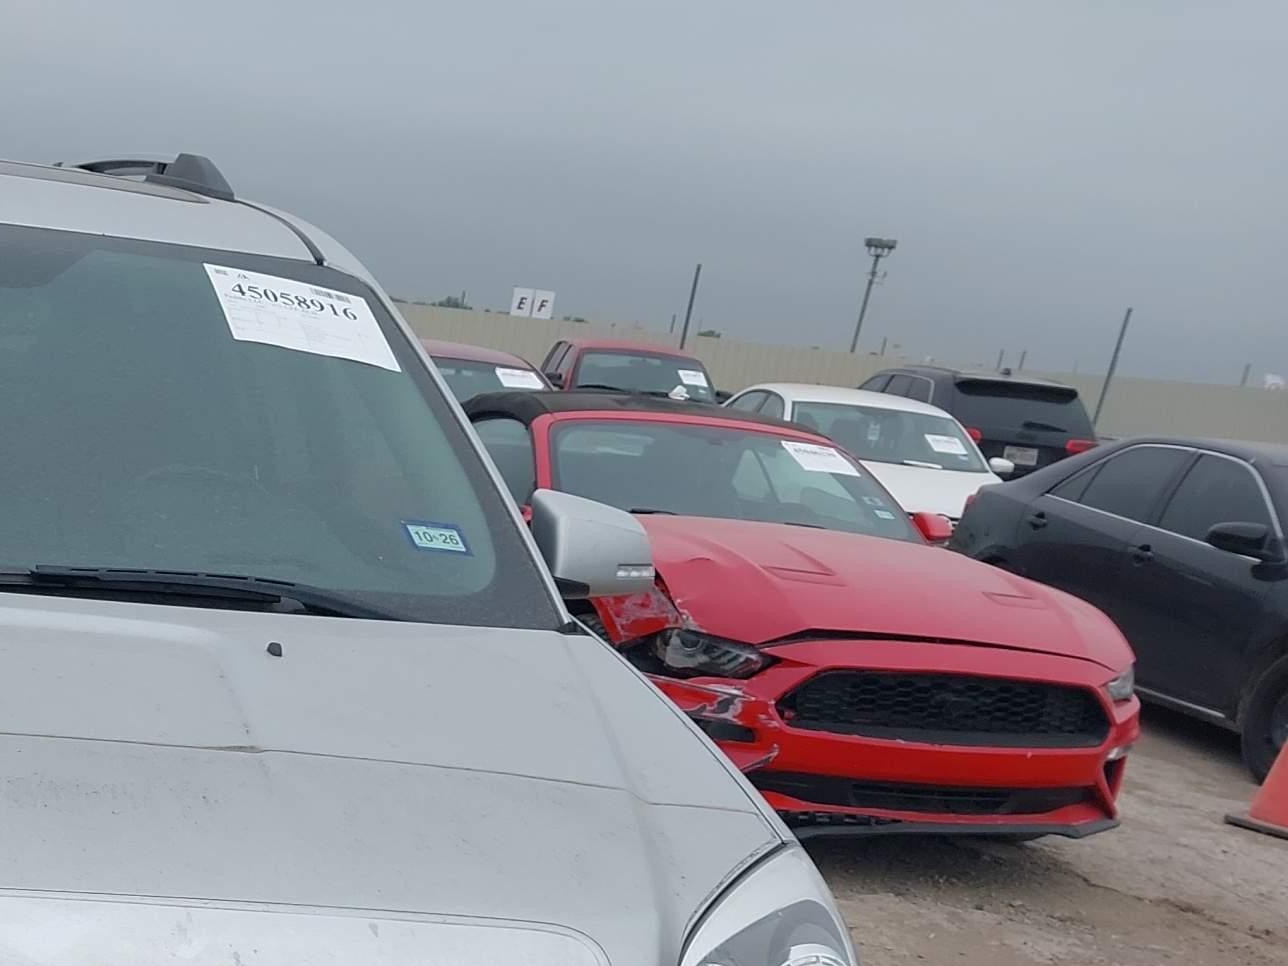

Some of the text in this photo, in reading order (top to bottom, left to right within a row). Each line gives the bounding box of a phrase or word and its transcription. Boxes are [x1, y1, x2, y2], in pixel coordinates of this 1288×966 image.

[231, 283, 358, 321] 45058916
[516, 296, 528, 310] E
[537, 299, 549, 313] F
